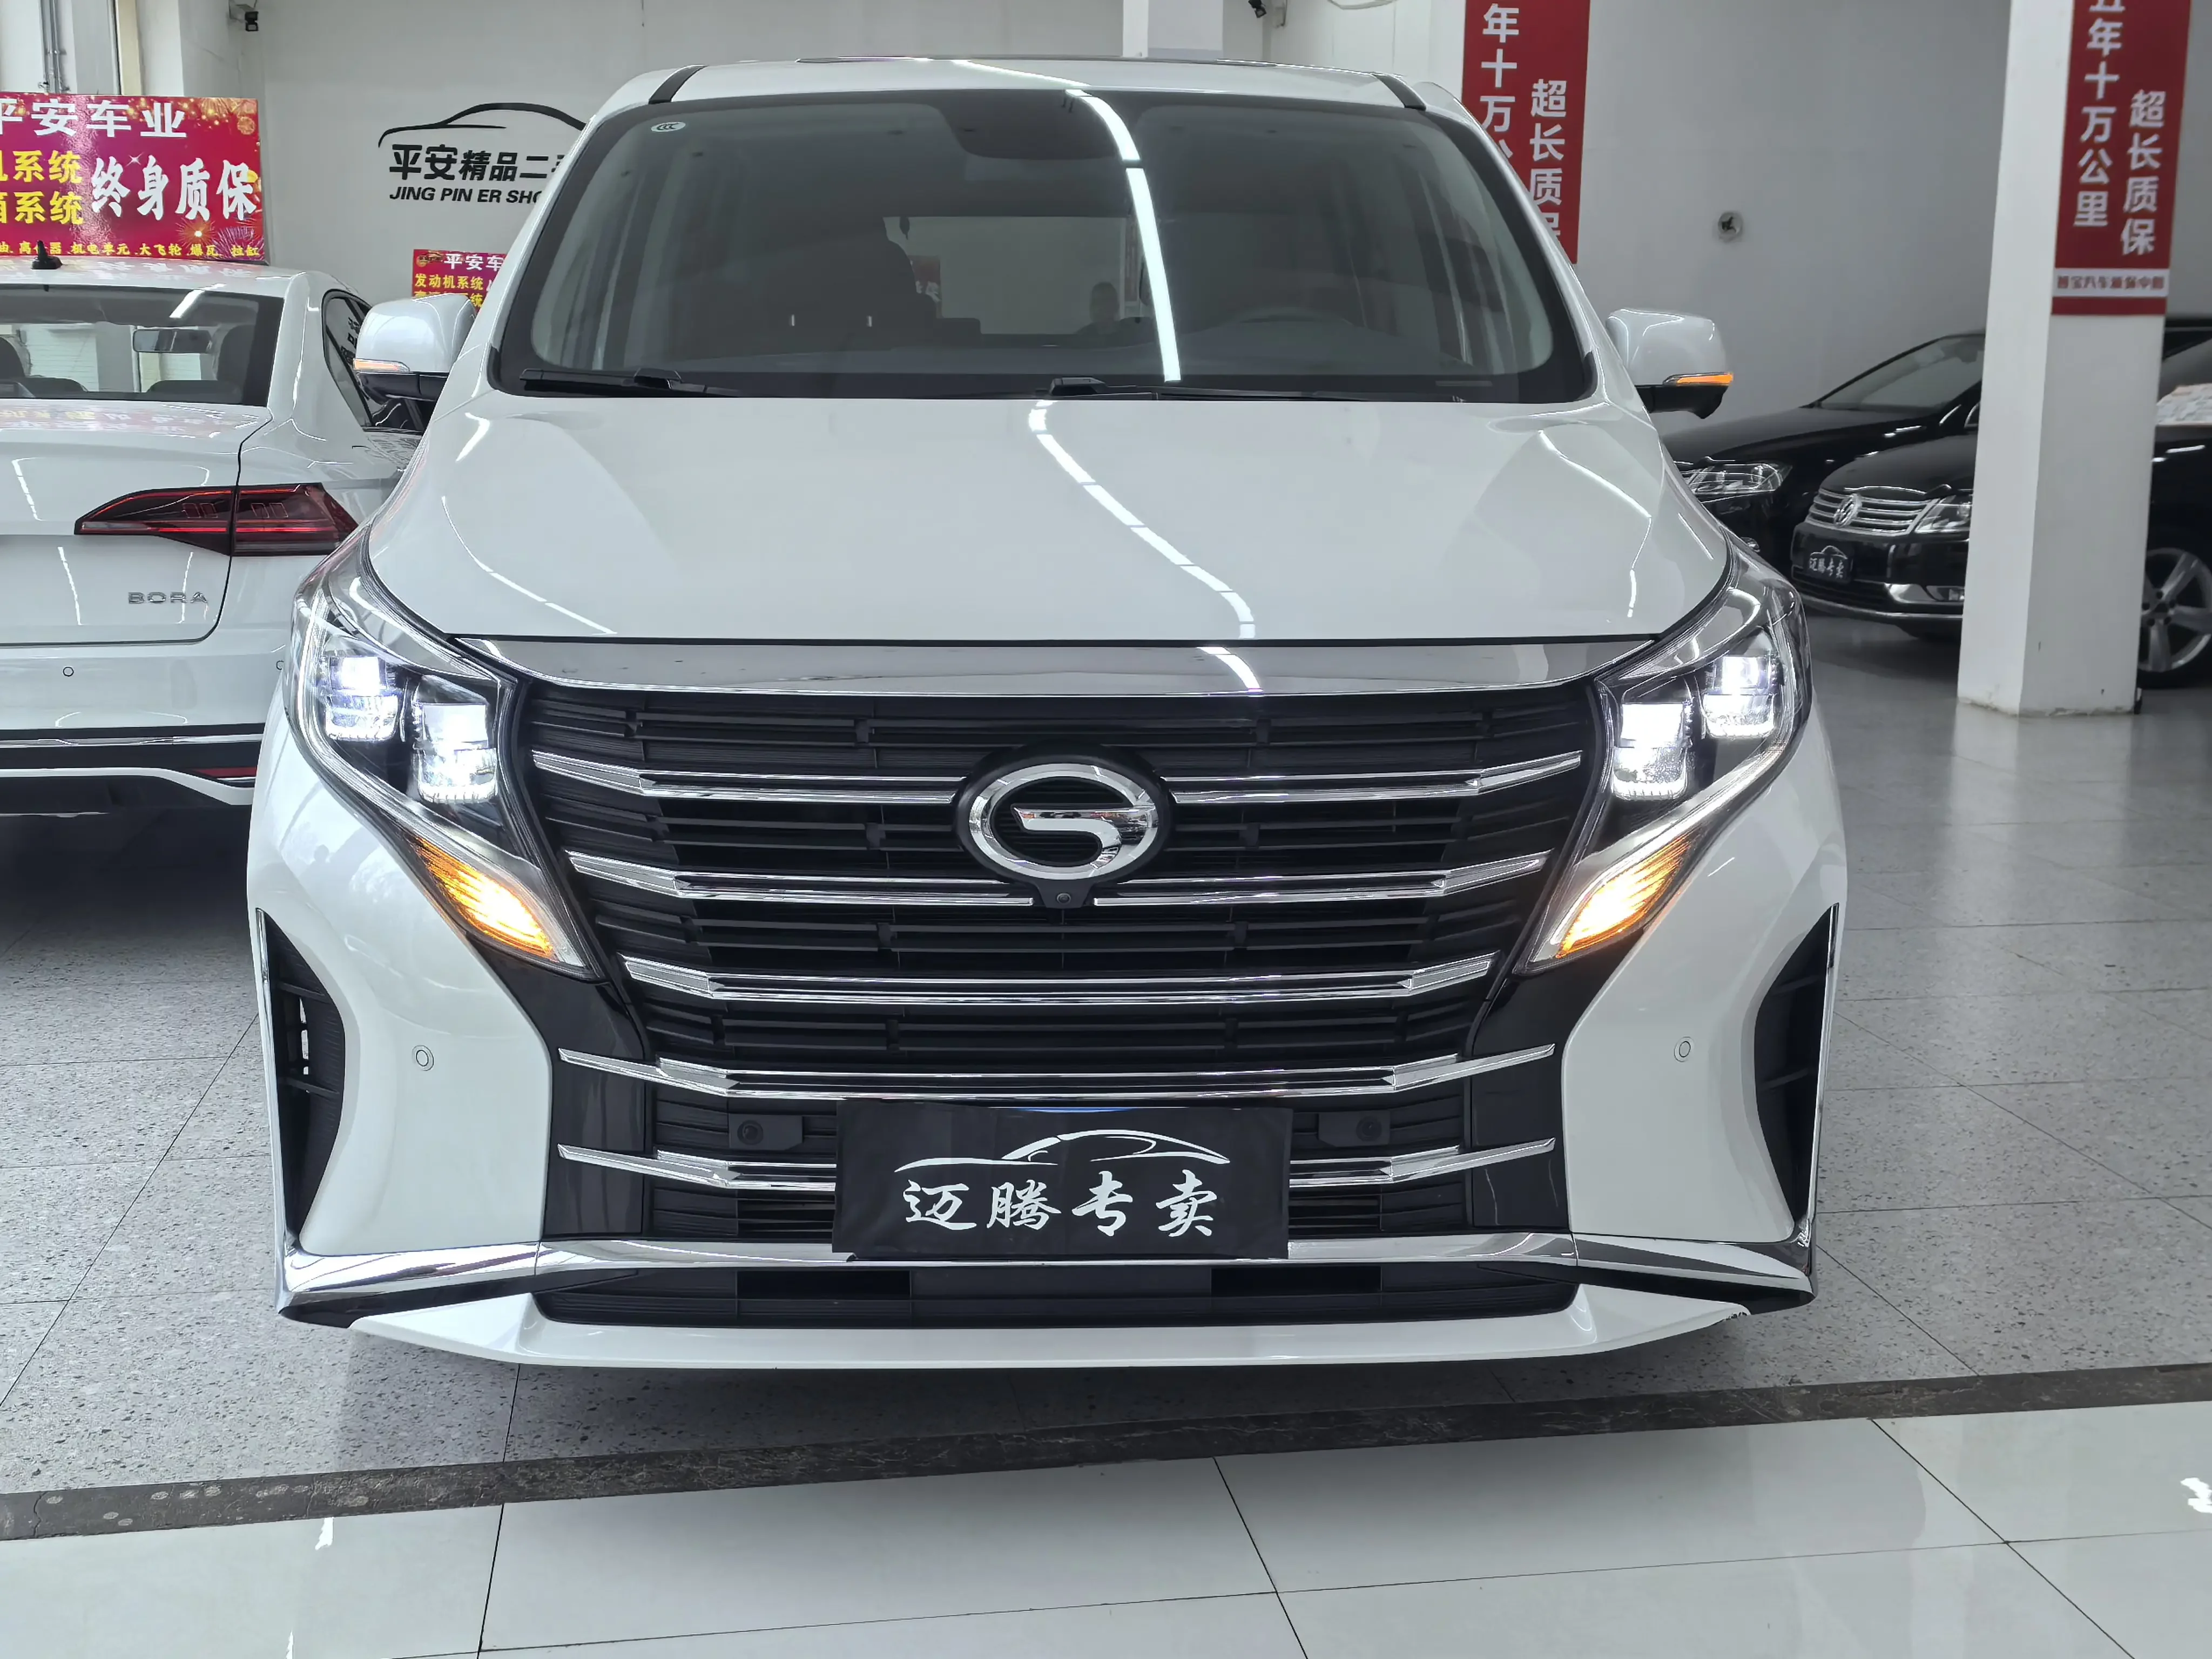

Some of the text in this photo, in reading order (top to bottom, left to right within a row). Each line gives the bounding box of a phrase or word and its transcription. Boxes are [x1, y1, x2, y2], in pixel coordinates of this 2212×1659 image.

[1478, 3, 1519, 158] 年十万
[0, 150, 83, 184] 系统
[389, 144, 565, 181] 平安精品二
[2120, 89, 2166, 255] 超长质保
[91, 154, 257, 221] 终身质保
[389, 186, 436, 201] JING
[440, 187, 473, 202] PIN
[477, 189, 501, 203] ER
[0, 191, 84, 225] 系统
[415, 273, 484, 291] 发动机系统
[128, 592, 208, 604] BORA
[903, 1170, 1219, 1237] 迈腾专卖
